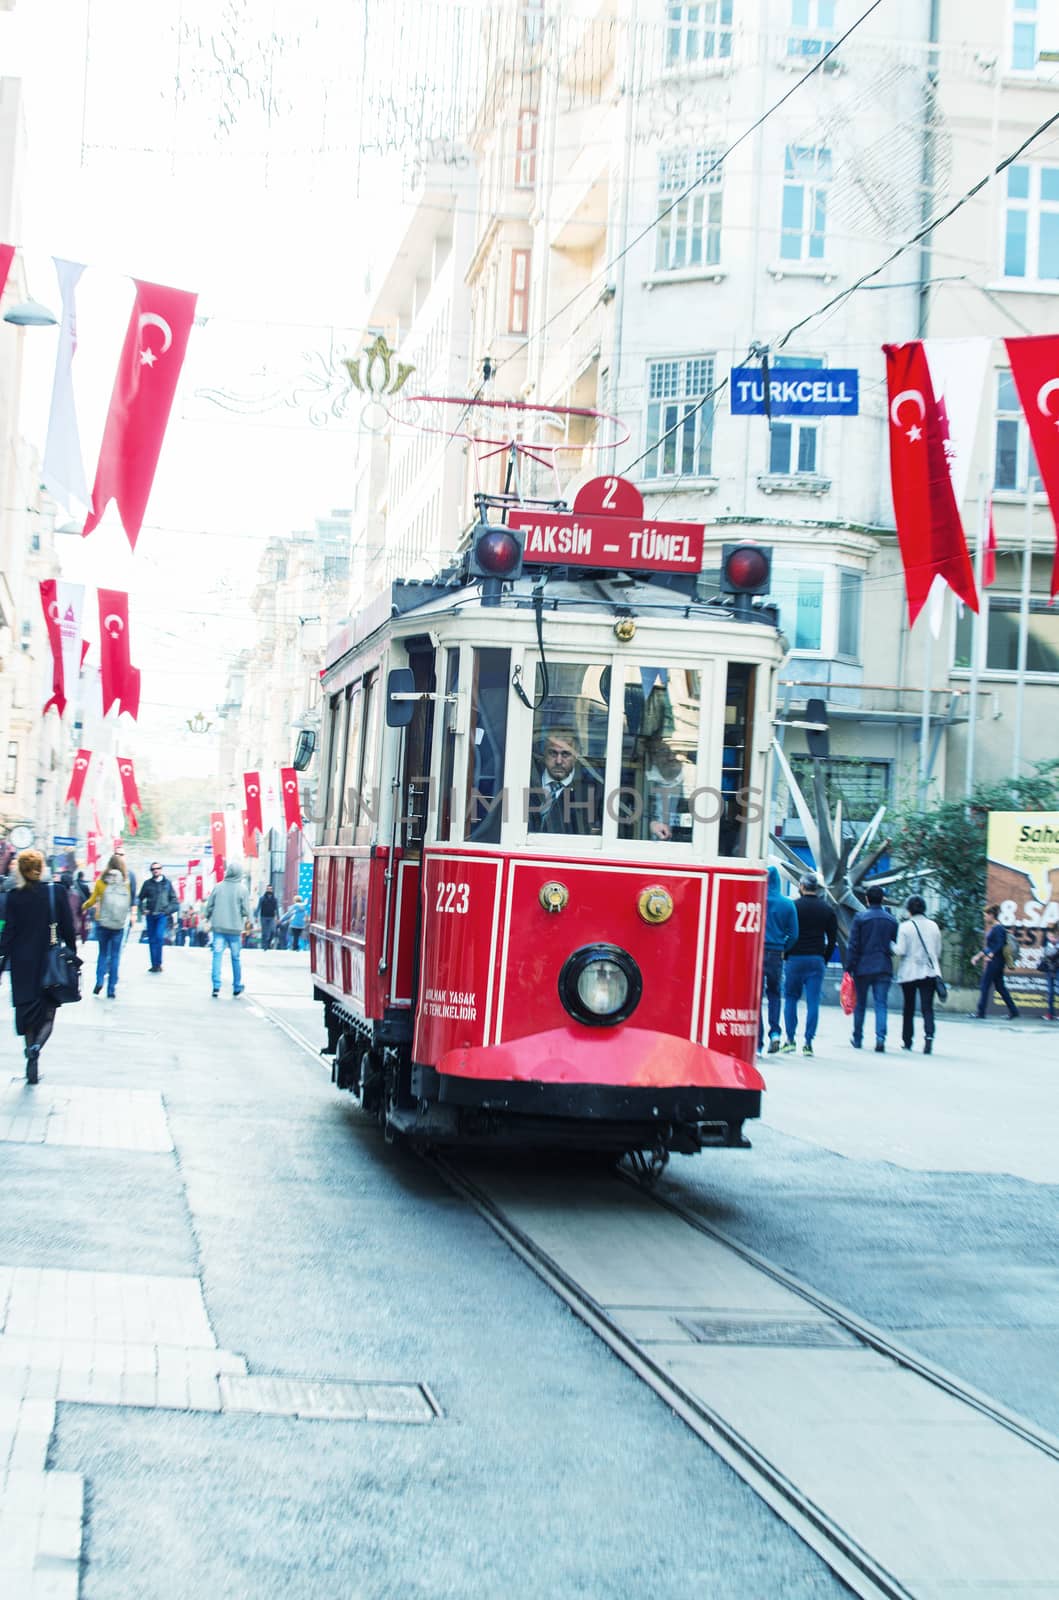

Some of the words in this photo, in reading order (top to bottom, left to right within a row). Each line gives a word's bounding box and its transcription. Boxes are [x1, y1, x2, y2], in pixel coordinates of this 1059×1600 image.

[737, 381, 853, 402] TURKCELL
[602, 478, 618, 509] 2
[519, 523, 592, 555] TAKSİM
[628, 528, 696, 563] TÜNEL
[435, 881, 470, 914] 223
[449, 991, 476, 1006] YASAK
